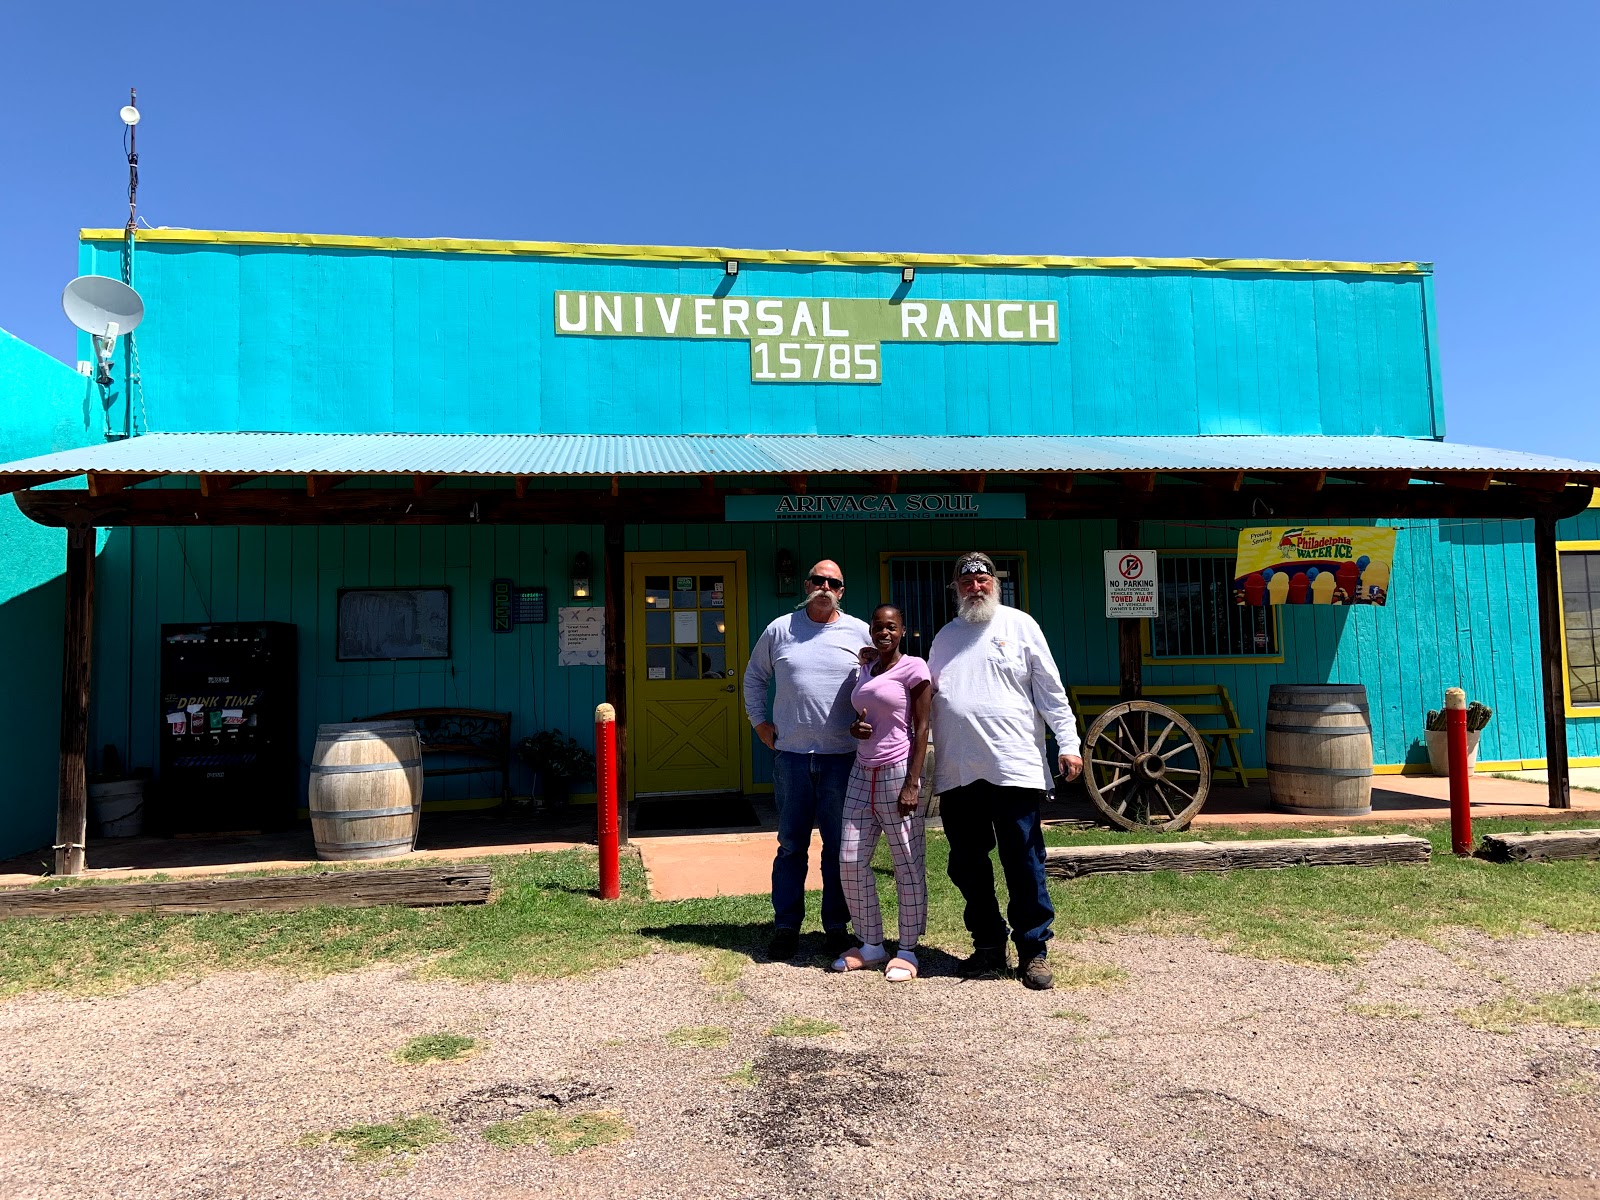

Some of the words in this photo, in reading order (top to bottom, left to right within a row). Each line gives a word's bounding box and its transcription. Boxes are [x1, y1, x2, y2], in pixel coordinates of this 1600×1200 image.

[558, 294, 849, 338] UNIVERSAL
[901, 303, 1056, 339] RANCH
[754, 342, 877, 381] 15785
[775, 495, 897, 513] ARIVACA
[905, 495, 979, 512] SOUL
[1250, 530, 1272, 539] Proudly
[1297, 536, 1351, 550] Philadelphia
[1297, 545, 1332, 558] WATER
[1334, 544, 1353, 558] ICE
[496, 584, 508, 629] OPEN
[225, 695, 257, 708] TIME
